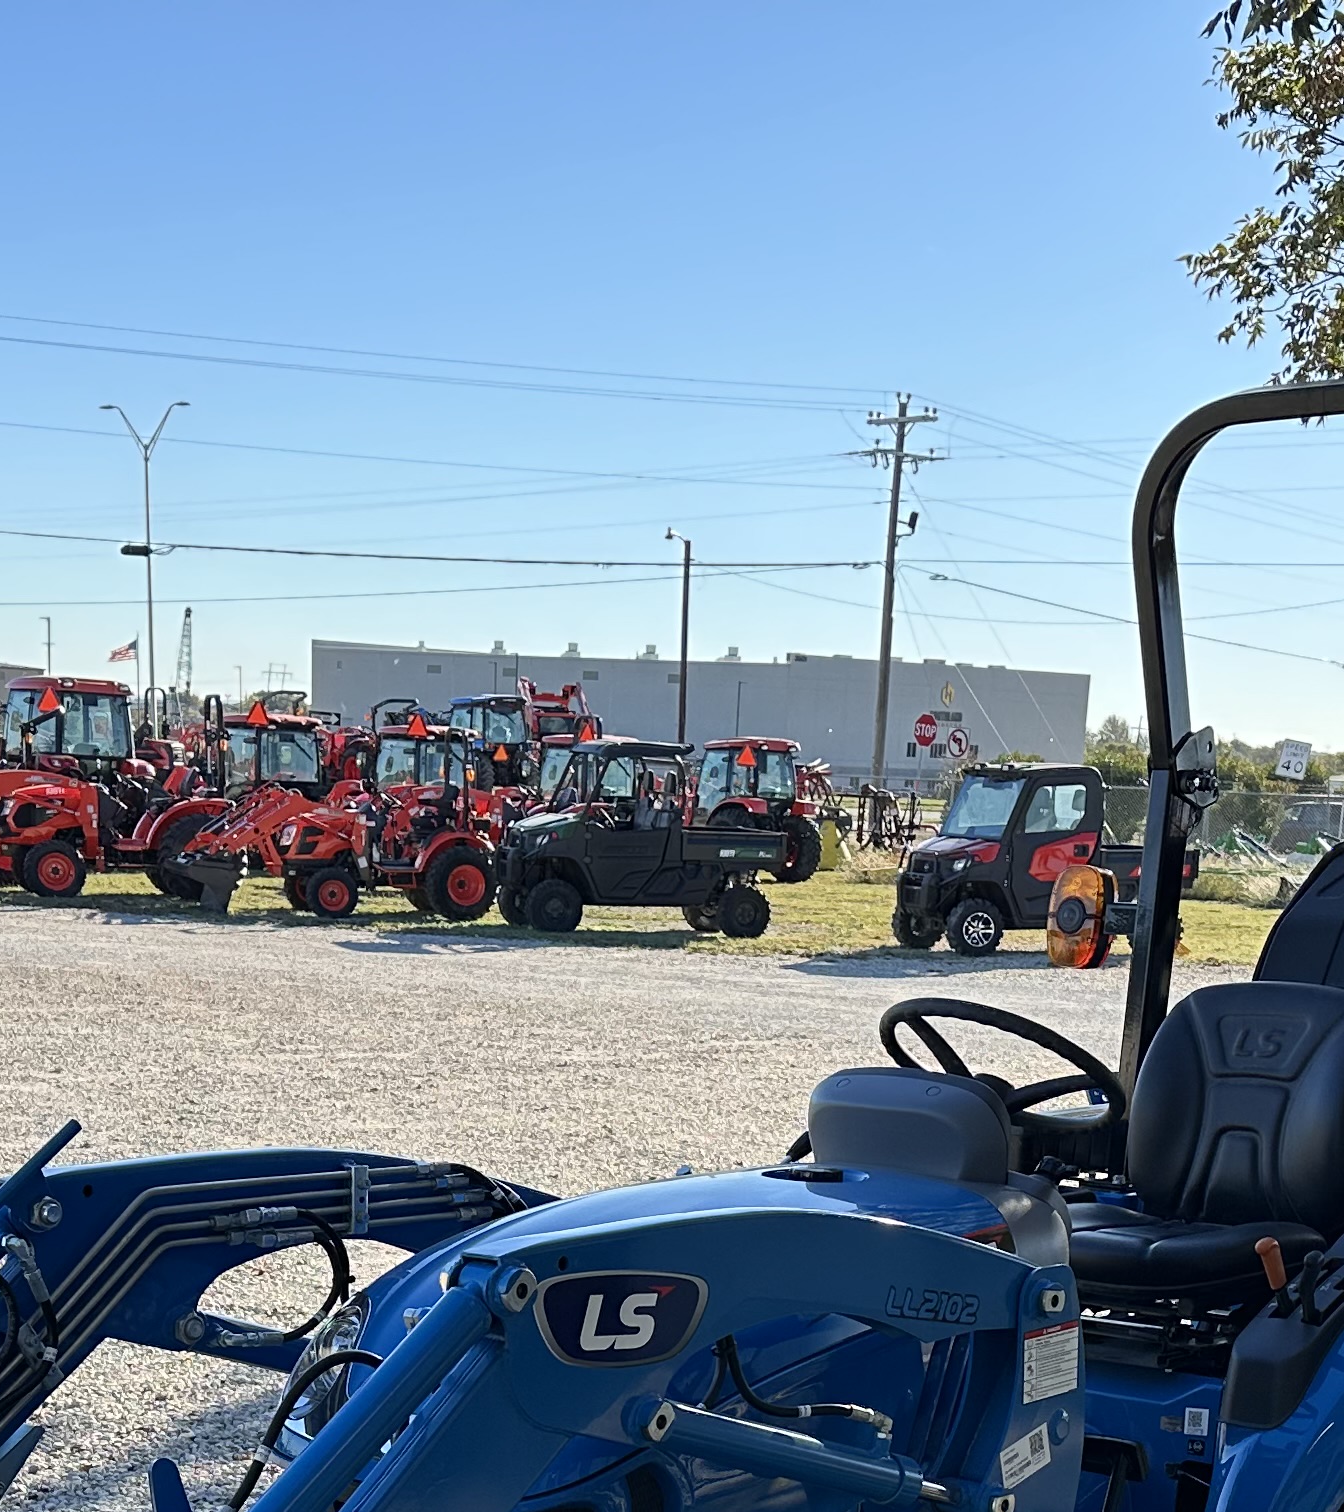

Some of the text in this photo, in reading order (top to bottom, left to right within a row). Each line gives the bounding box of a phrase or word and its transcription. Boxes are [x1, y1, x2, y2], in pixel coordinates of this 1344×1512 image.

[914, 723, 937, 738] STOP
[1280, 760, 1304, 774] 40
[1233, 1028, 1287, 1059] LS
[885, 1285, 981, 1326] LL2102
[579, 1293, 659, 1352] LS
